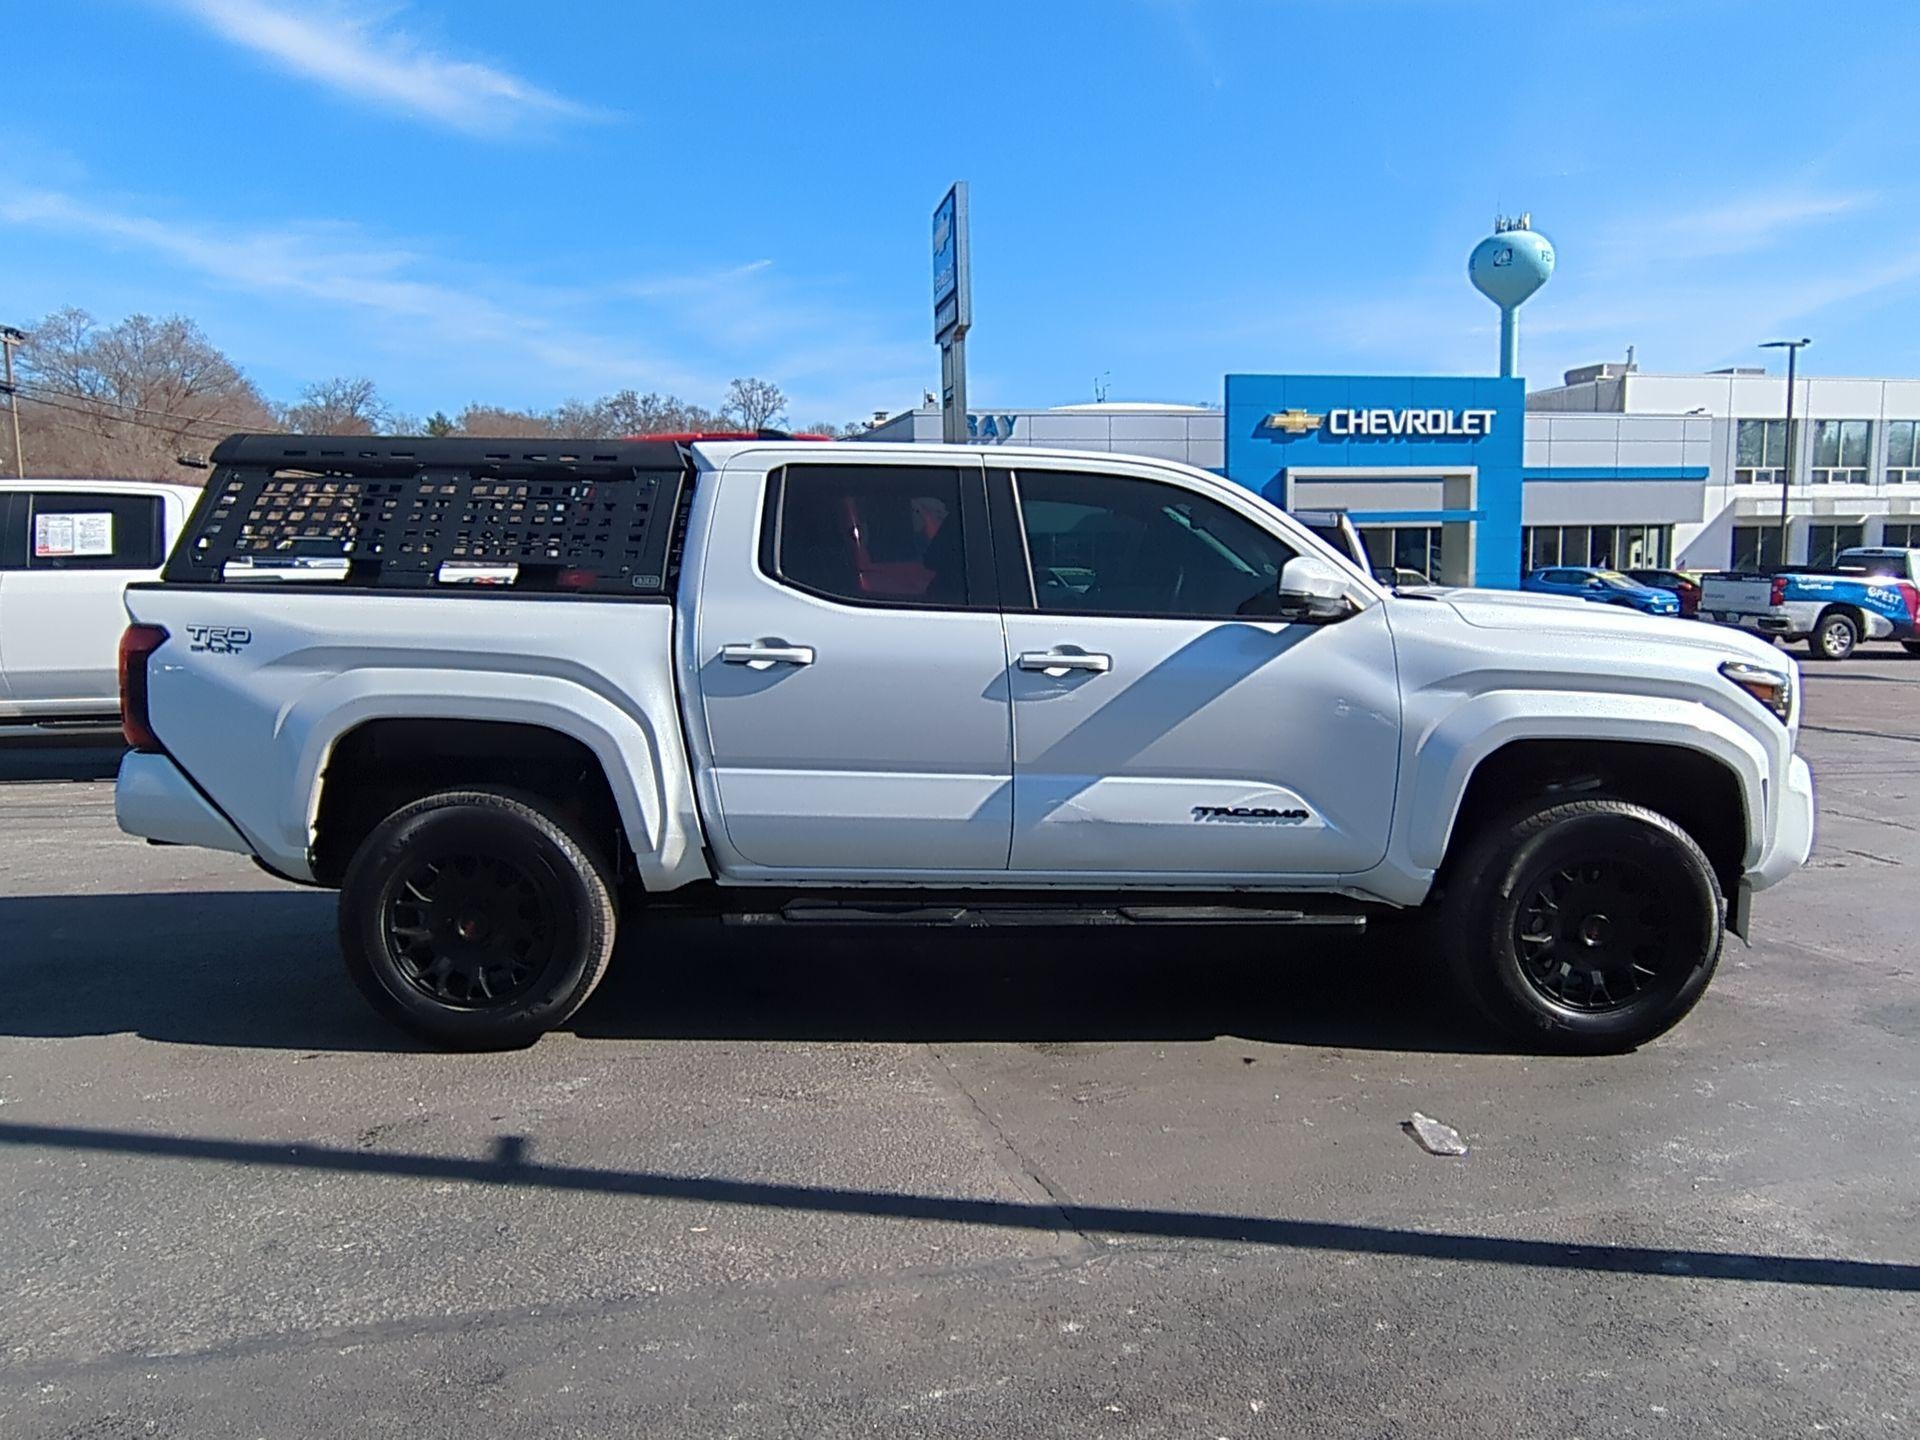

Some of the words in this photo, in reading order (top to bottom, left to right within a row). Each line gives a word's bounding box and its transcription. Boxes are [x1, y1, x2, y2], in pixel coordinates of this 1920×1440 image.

[1330, 409, 1497, 435] CHEVROLET
[1876, 588, 1902, 605] PEST
[186, 625, 251, 648] TRD
[1191, 806, 1310, 819] TACOMA
